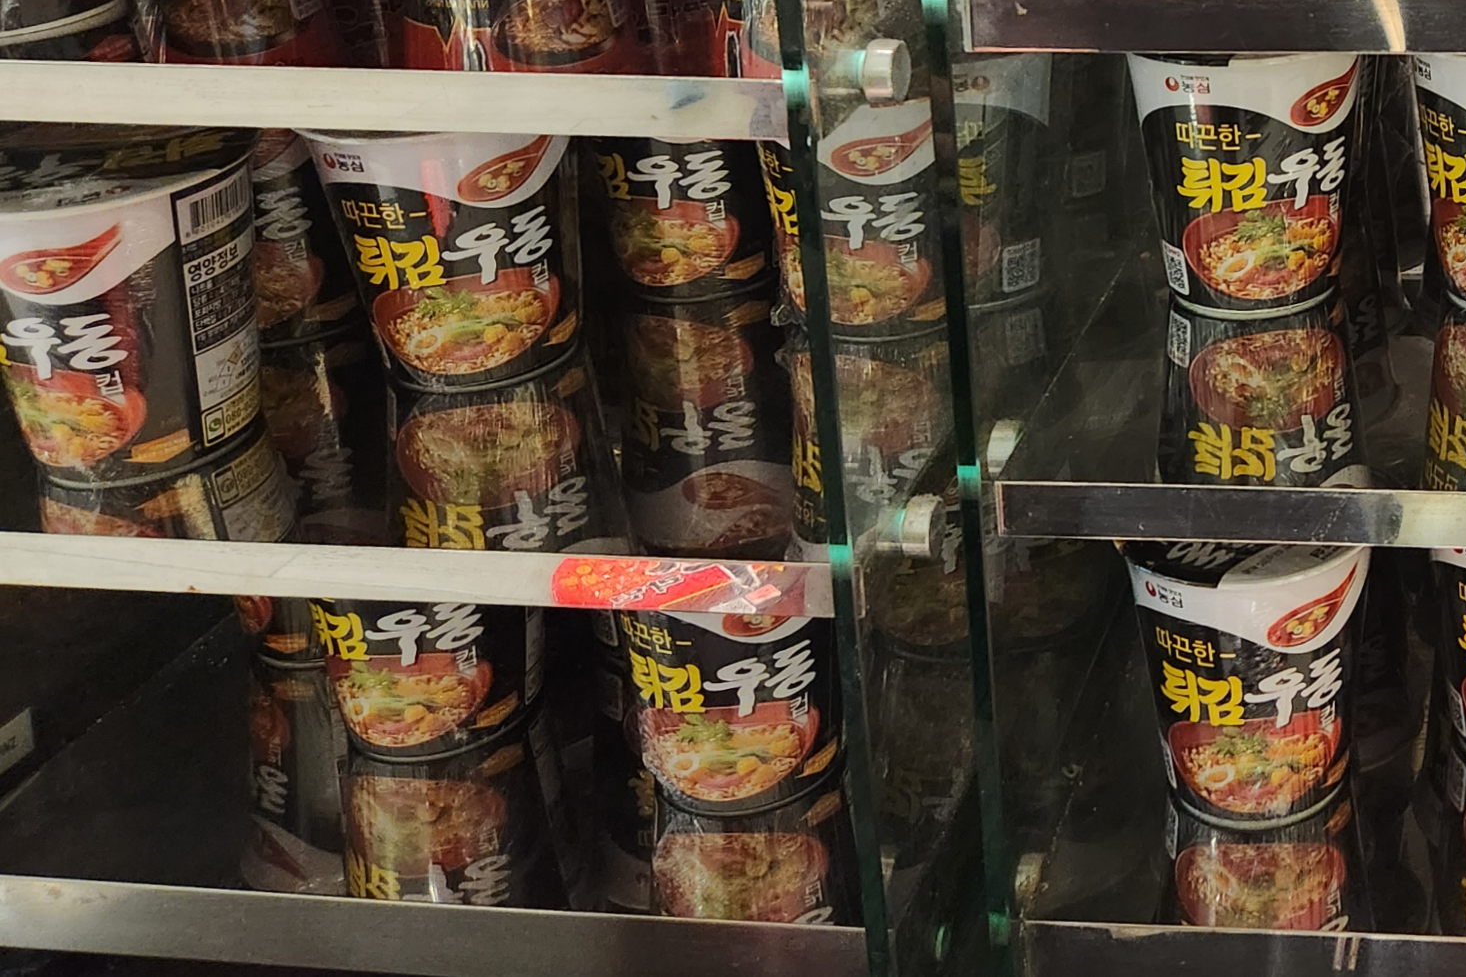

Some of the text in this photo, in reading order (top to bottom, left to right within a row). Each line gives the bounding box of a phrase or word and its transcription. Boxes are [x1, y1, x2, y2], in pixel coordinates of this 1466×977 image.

[1180, 81, 1211, 96] 농심
[336, 158, 366, 173] 농심
[598, 148, 733, 210] 김우동
[187, 242, 240, 283] 영양정보
[0, 312, 129, 381] 우동
[1157, 589, 1185, 610] 농심
